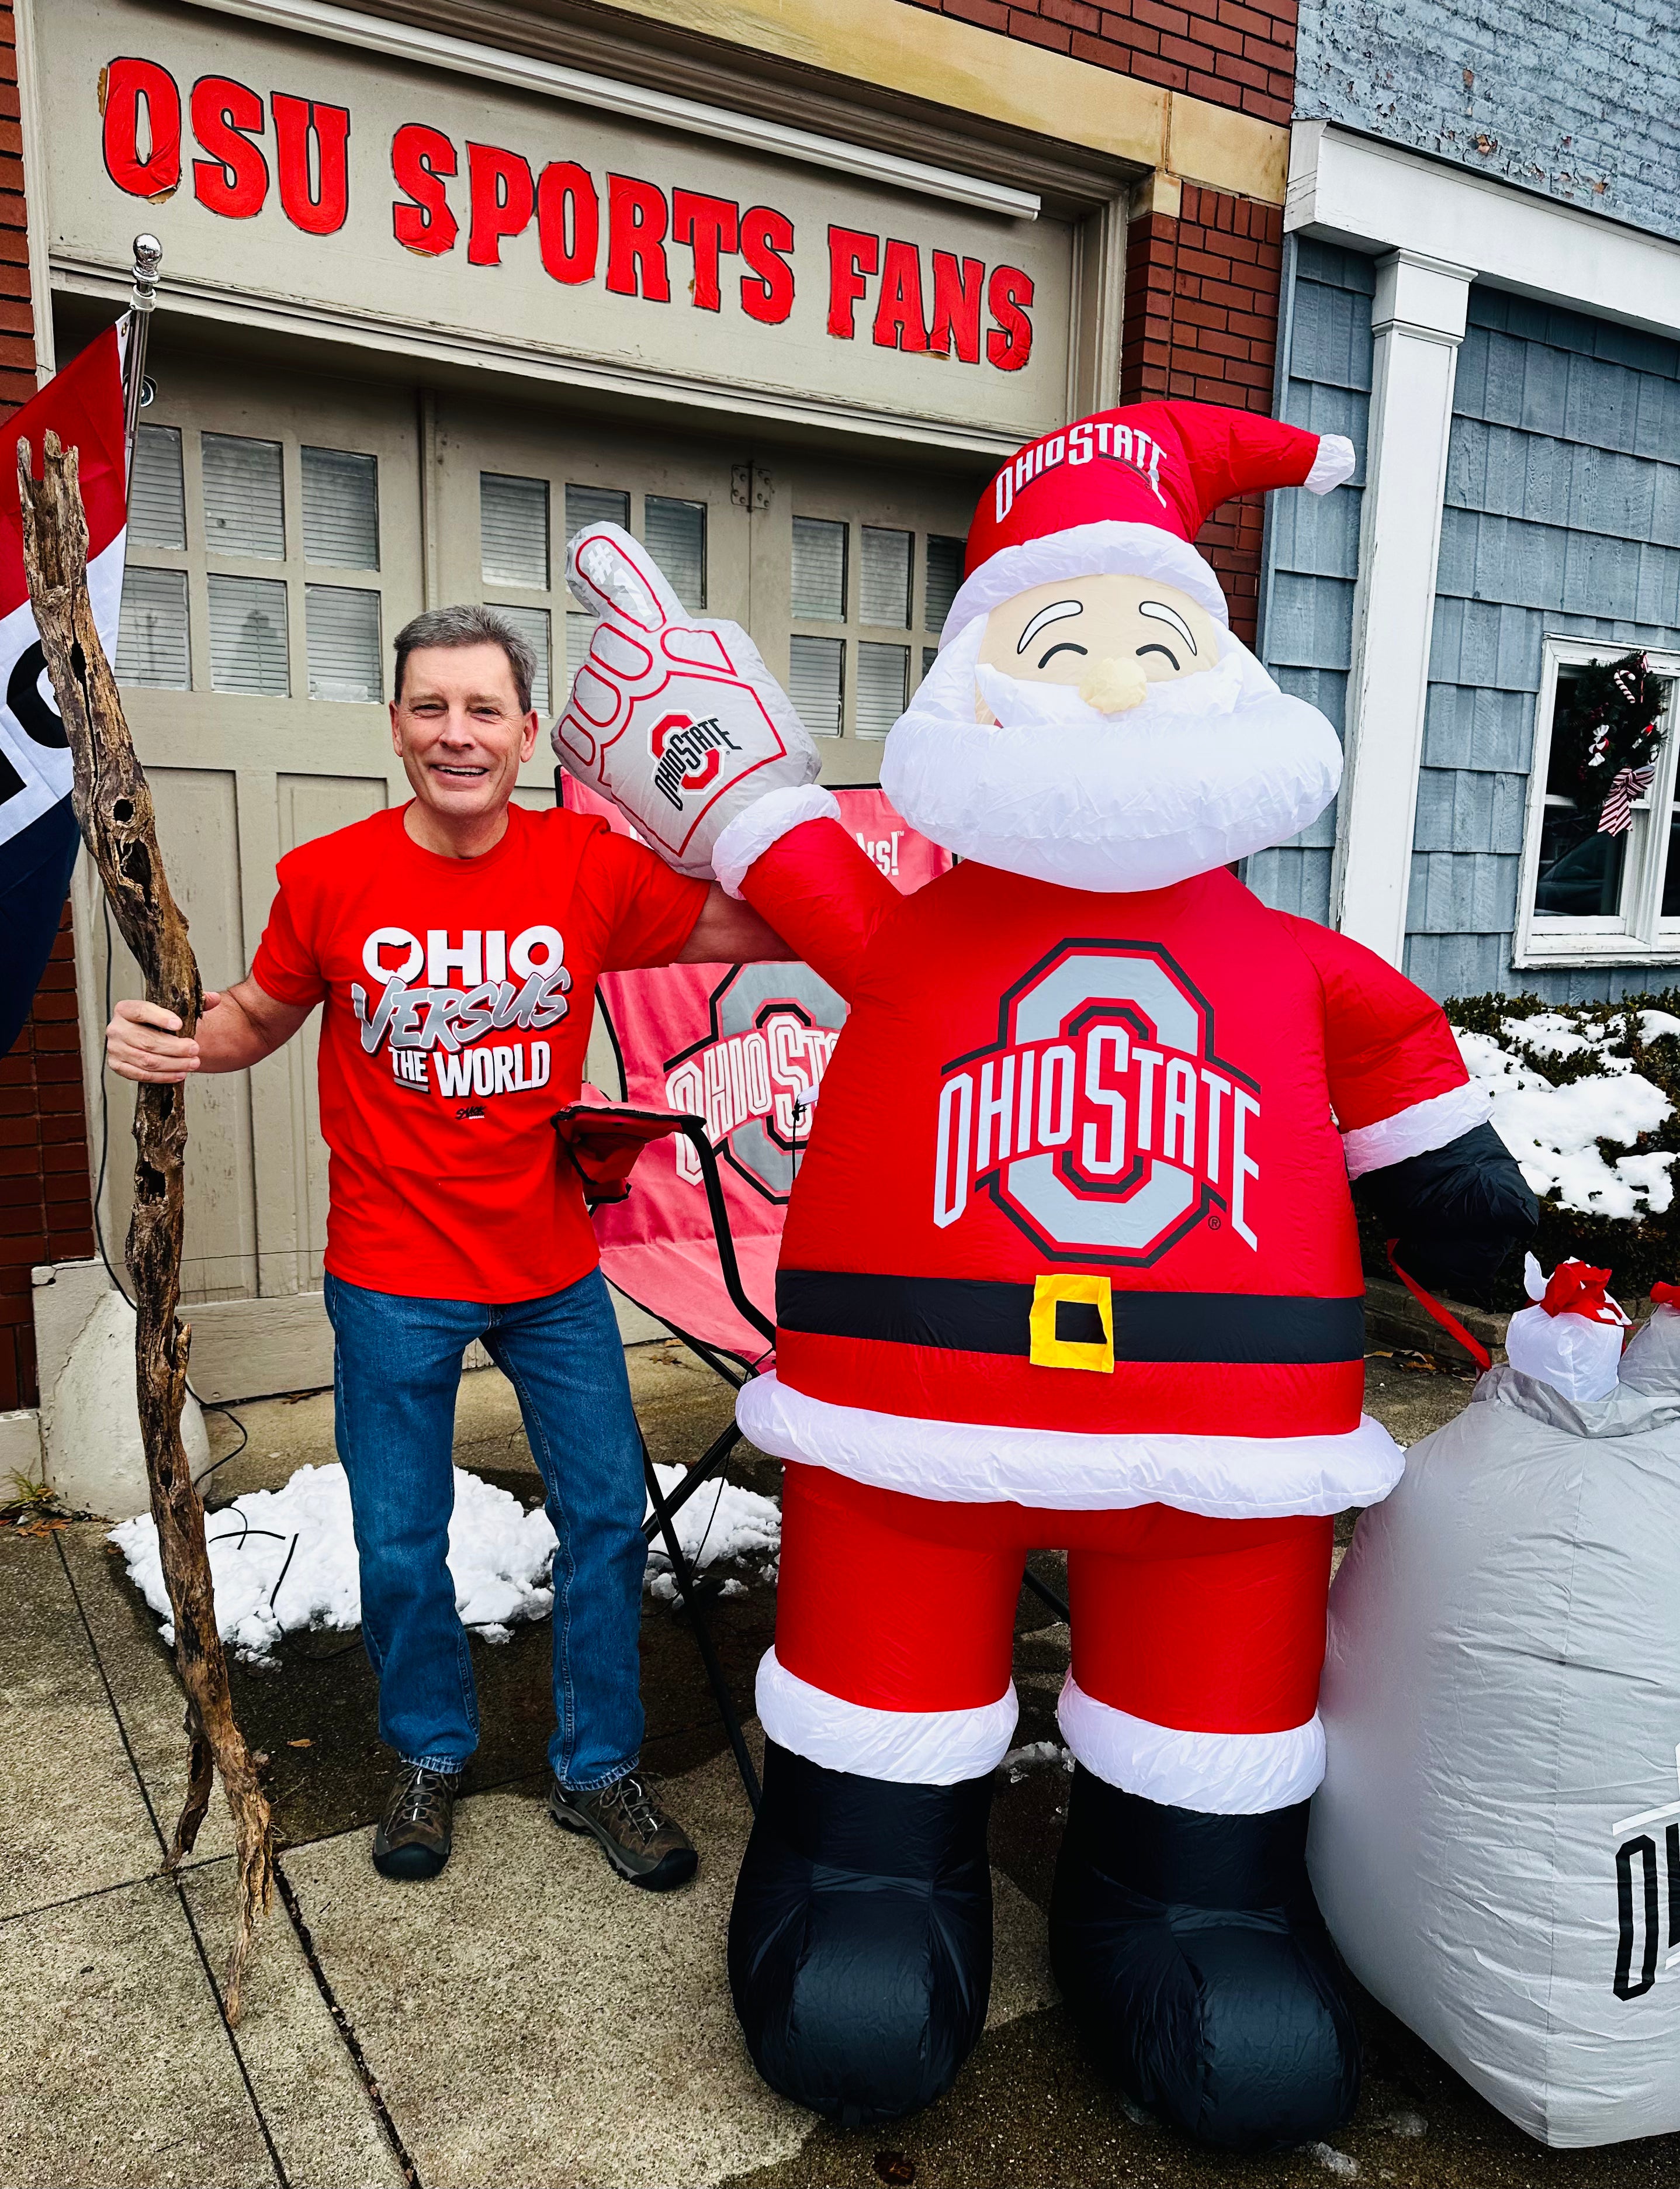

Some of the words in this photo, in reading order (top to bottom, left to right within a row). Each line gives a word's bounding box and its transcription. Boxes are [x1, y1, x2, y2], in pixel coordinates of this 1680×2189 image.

[103, 56, 350, 236] OSU
[392, 123, 795, 325] SPORTS
[827, 224, 1034, 372] FANS
[362, 925, 564, 987] OHIO
[351, 966, 571, 1053] VERSUS
[388, 1046, 429, 1083] THE
[432, 1040, 551, 1097] WORLD
